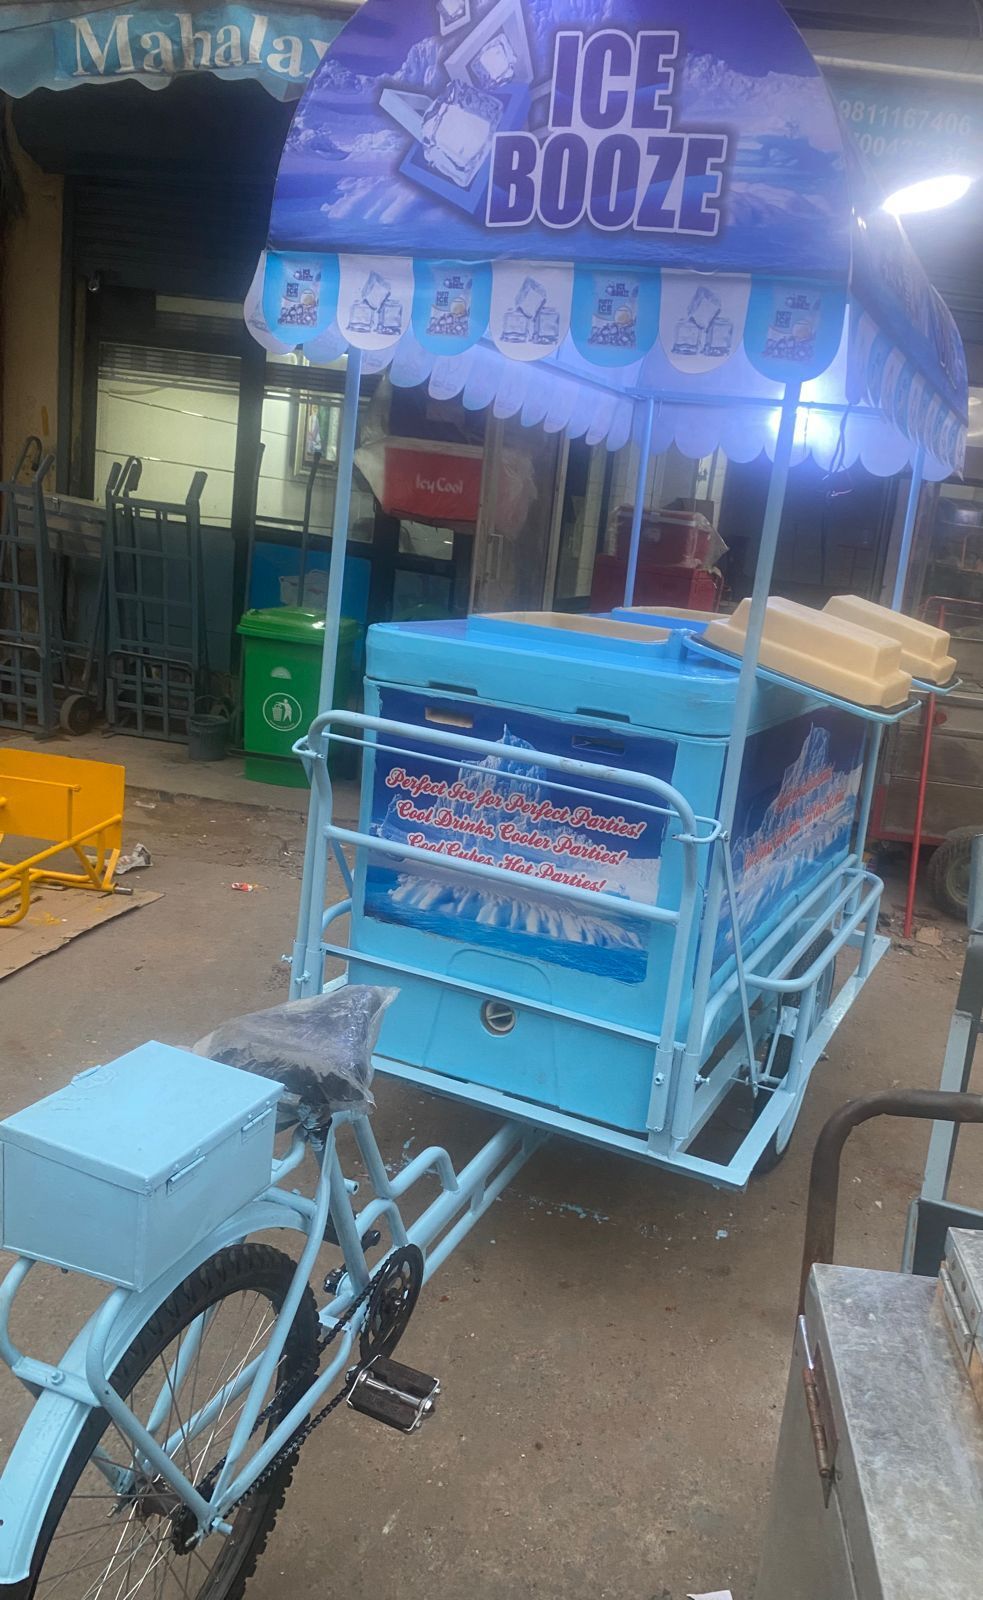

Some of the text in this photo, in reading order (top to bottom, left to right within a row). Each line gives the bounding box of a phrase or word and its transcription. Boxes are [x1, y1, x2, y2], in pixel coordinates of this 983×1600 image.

[549, 29, 680, 132] ICE
[485, 131, 728, 236] BOOZE
[386, 768, 646, 839] Perfect Ice for Perfect Parties!
[397, 800, 627, 865] Cool Drinks, Cooler Parties!
[498, 854, 535, 875] Hot
[535, 861, 607, 892] Parties!
